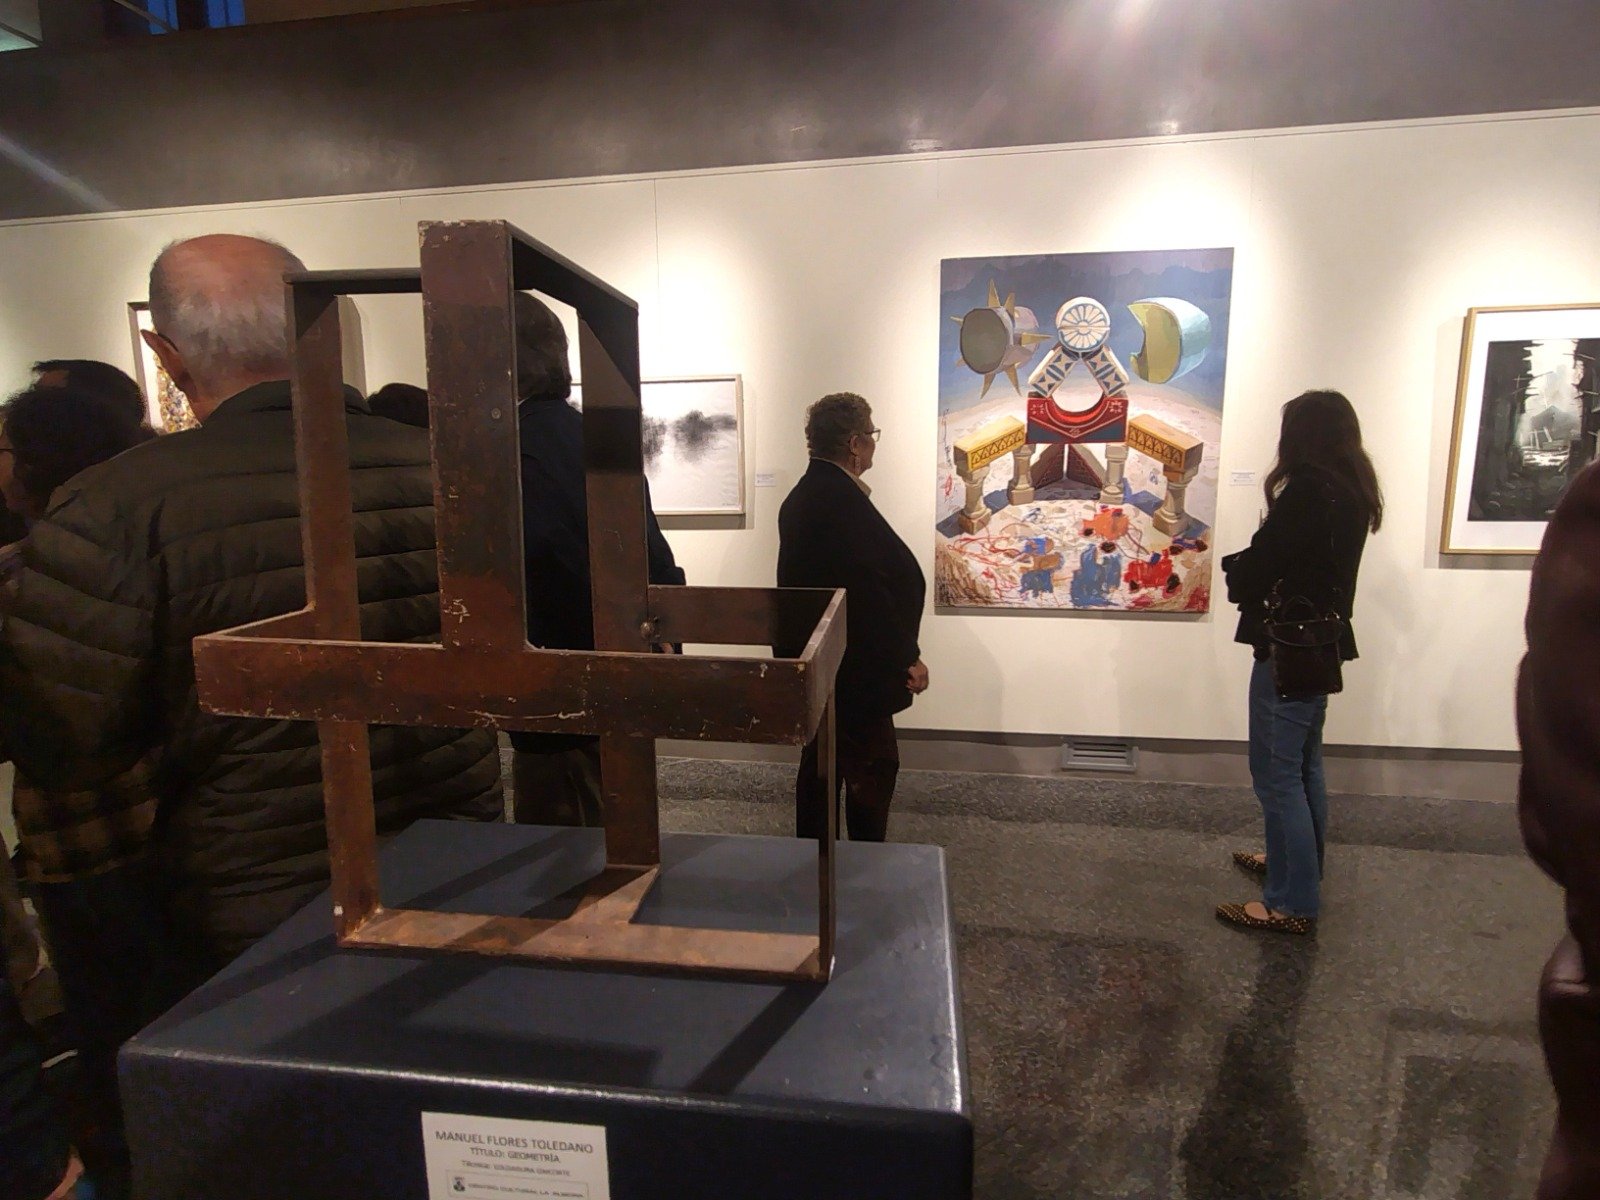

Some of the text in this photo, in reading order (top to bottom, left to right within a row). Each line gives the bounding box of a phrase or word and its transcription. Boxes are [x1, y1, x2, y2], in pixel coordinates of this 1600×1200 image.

[435, 1131, 593, 1153] MANUEL FLORES TOLEDANO
